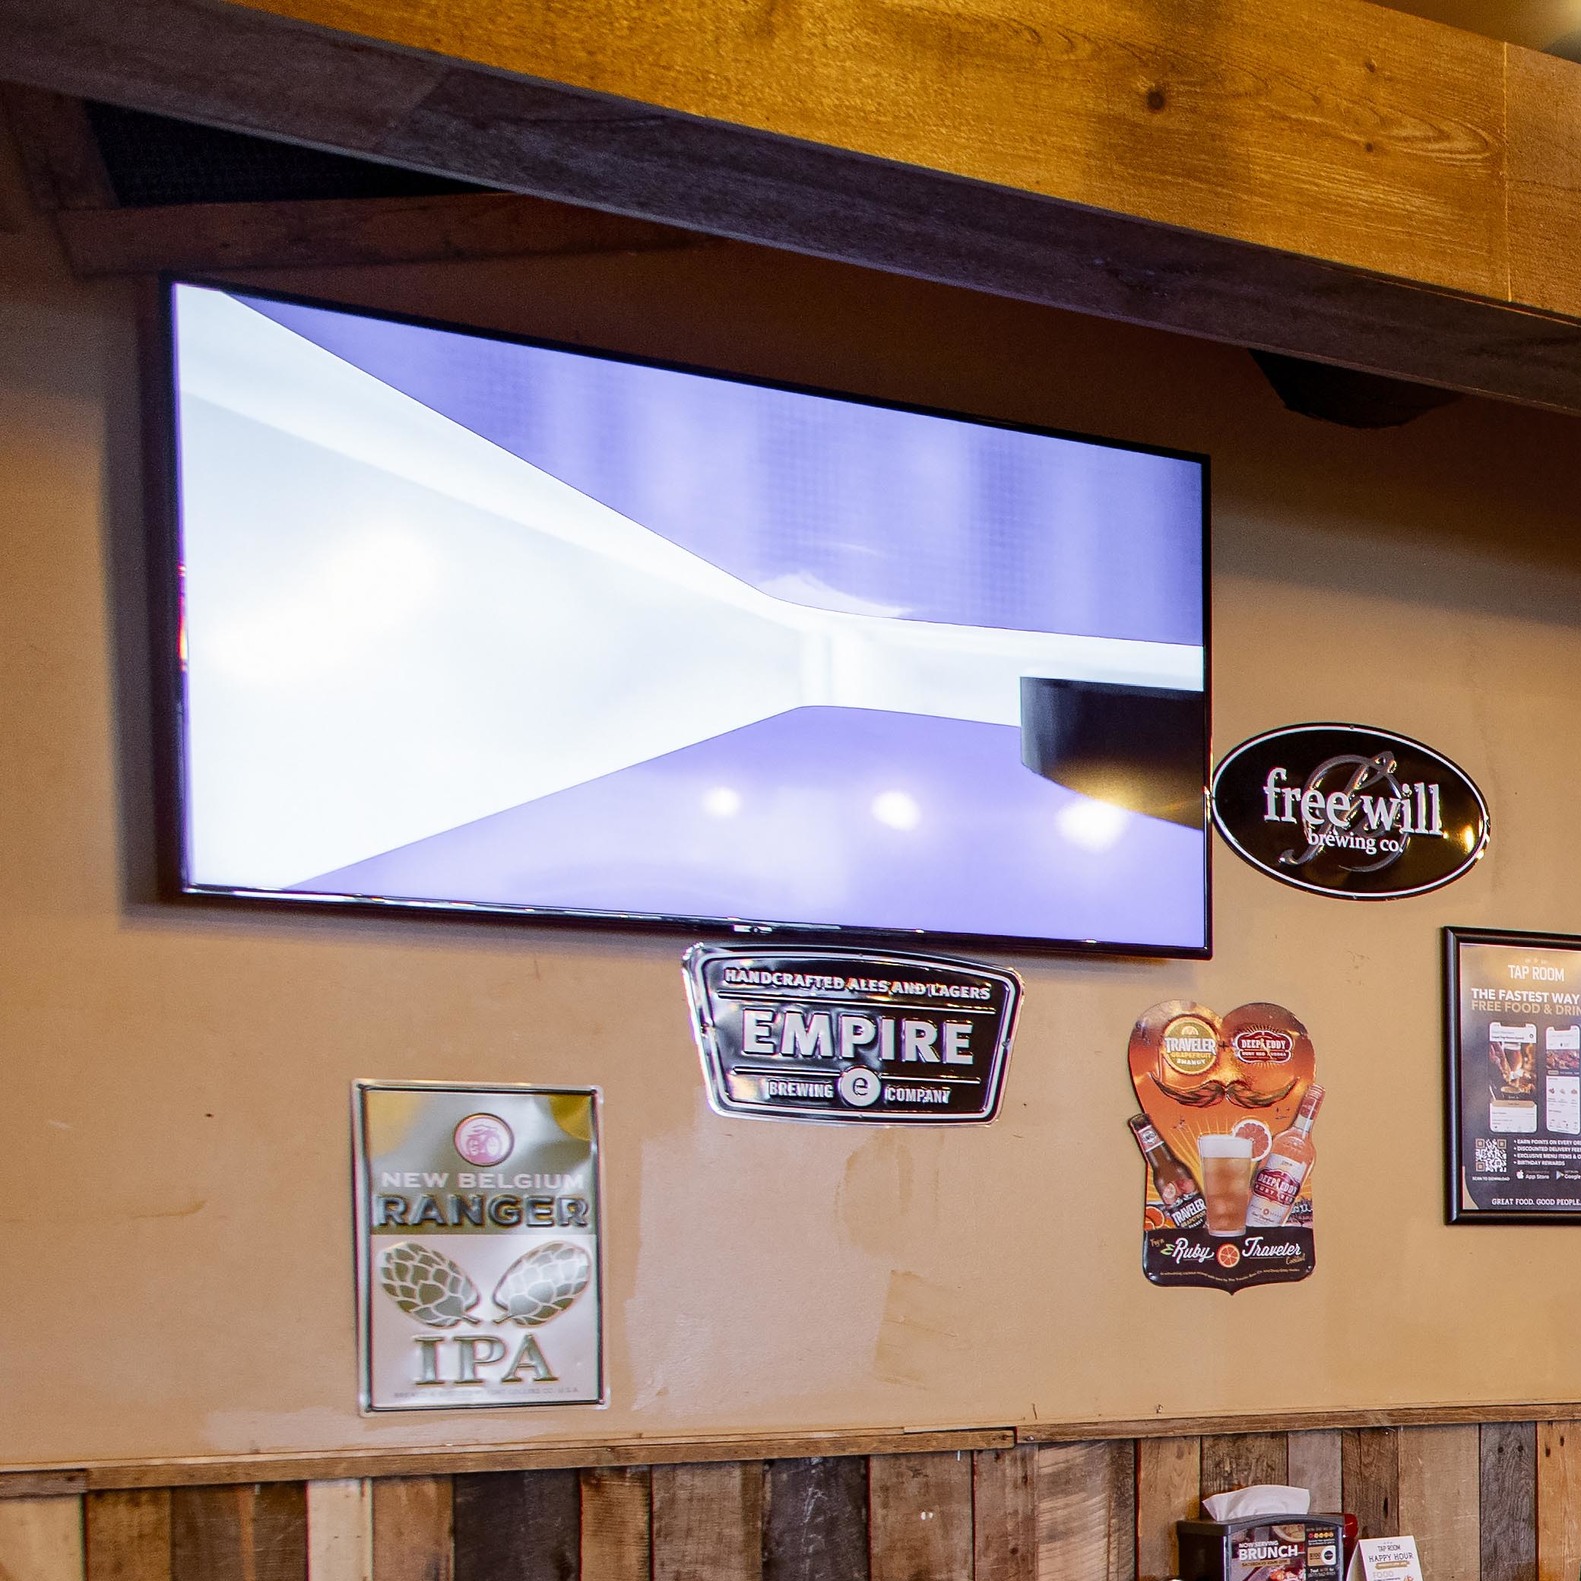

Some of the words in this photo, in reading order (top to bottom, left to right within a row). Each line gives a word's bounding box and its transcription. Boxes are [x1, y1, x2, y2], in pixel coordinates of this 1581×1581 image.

[1263, 767, 1350, 828] free
[1361, 782, 1443, 836] will
[1308, 829, 1376, 854] brewing
[725, 968, 845, 990] HANDCRAFTED
[846, 978, 888, 994] ALES
[891, 980, 926, 995] AND
[930, 983, 991, 1000] LAGERS
[1508, 964, 1529, 980] TAP
[1532, 967, 1564, 982] ROOM
[1471, 988, 1496, 1000] THE
[1499, 990, 1549, 1002] FASTEST
[1552, 993, 1580, 1005] WAY
[1472, 1000, 1502, 1012] FREE
[1505, 1002, 1540, 1014] FOOD
[1544, 1004, 1552, 1014] &
[742, 1008, 974, 1064] EMPIRE
[1165, 1037, 1216, 1055] TRAVELER
[1242, 1039, 1260, 1049] DEEP
[1266, 1039, 1286, 1049] EDDY
[768, 1080, 834, 1098] BREWING
[887, 1087, 950, 1104] COMPANY
[381, 1173, 448, 1188] NEW
[458, 1173, 585, 1190] BELGIUM
[374, 1194, 588, 1228] RANGER
[1171, 1198, 1206, 1226] TRAVELER
[1172, 1238, 1214, 1264] Ruby
[1242, 1237, 1302, 1257] Traveler
[414, 1333, 559, 1386] IPA
[1238, 1545, 1298, 1560] BRUNCH
[1369, 1554, 1391, 1562] HAPPY
[1394, 1552, 1413, 1560] HOUR
